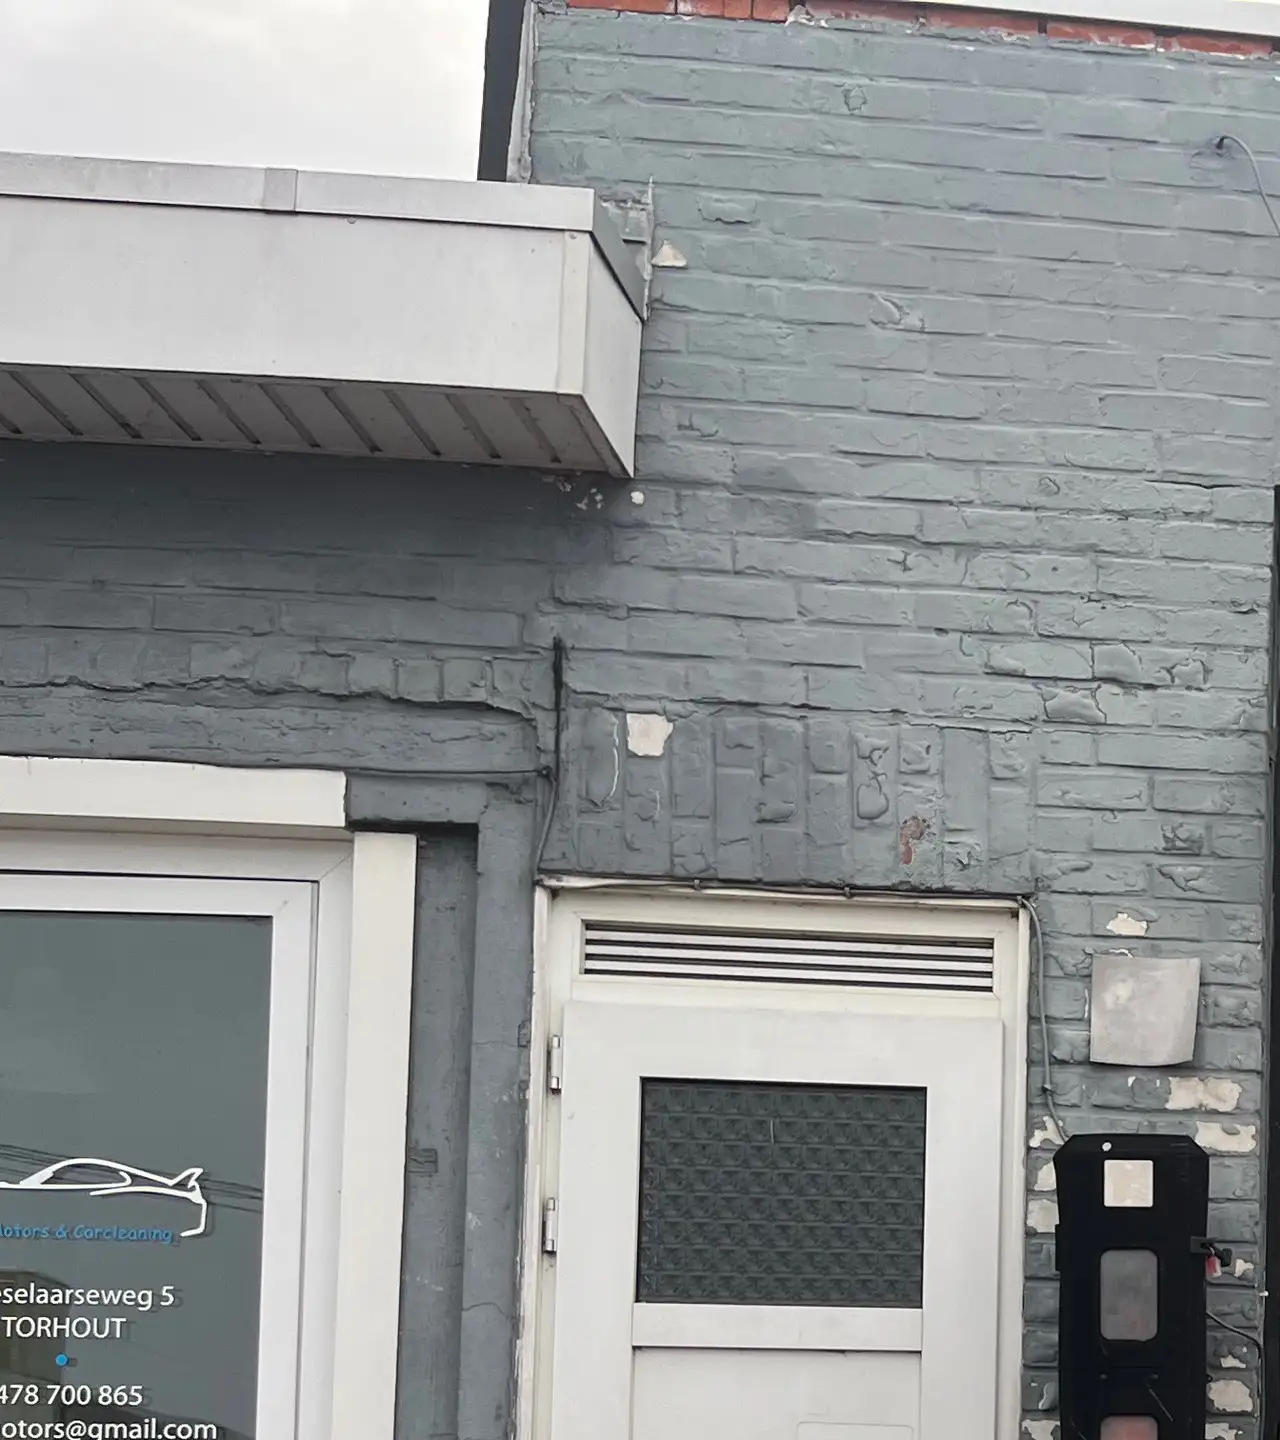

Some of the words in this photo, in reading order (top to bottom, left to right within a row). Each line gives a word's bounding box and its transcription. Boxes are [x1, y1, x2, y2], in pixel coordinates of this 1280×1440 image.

[0, 1223, 50, 1239] otors
[55, 1224, 68, 1239] &
[73, 1224, 172, 1244] Carcleaning
[0, 1282, 153, 1311] selaarseweg
[160, 1286, 175, 1306] 5
[1, 1316, 127, 1338] TORHOUT
[46, 1384, 92, 1405] 700
[98, 1384, 143, 1406] 865
